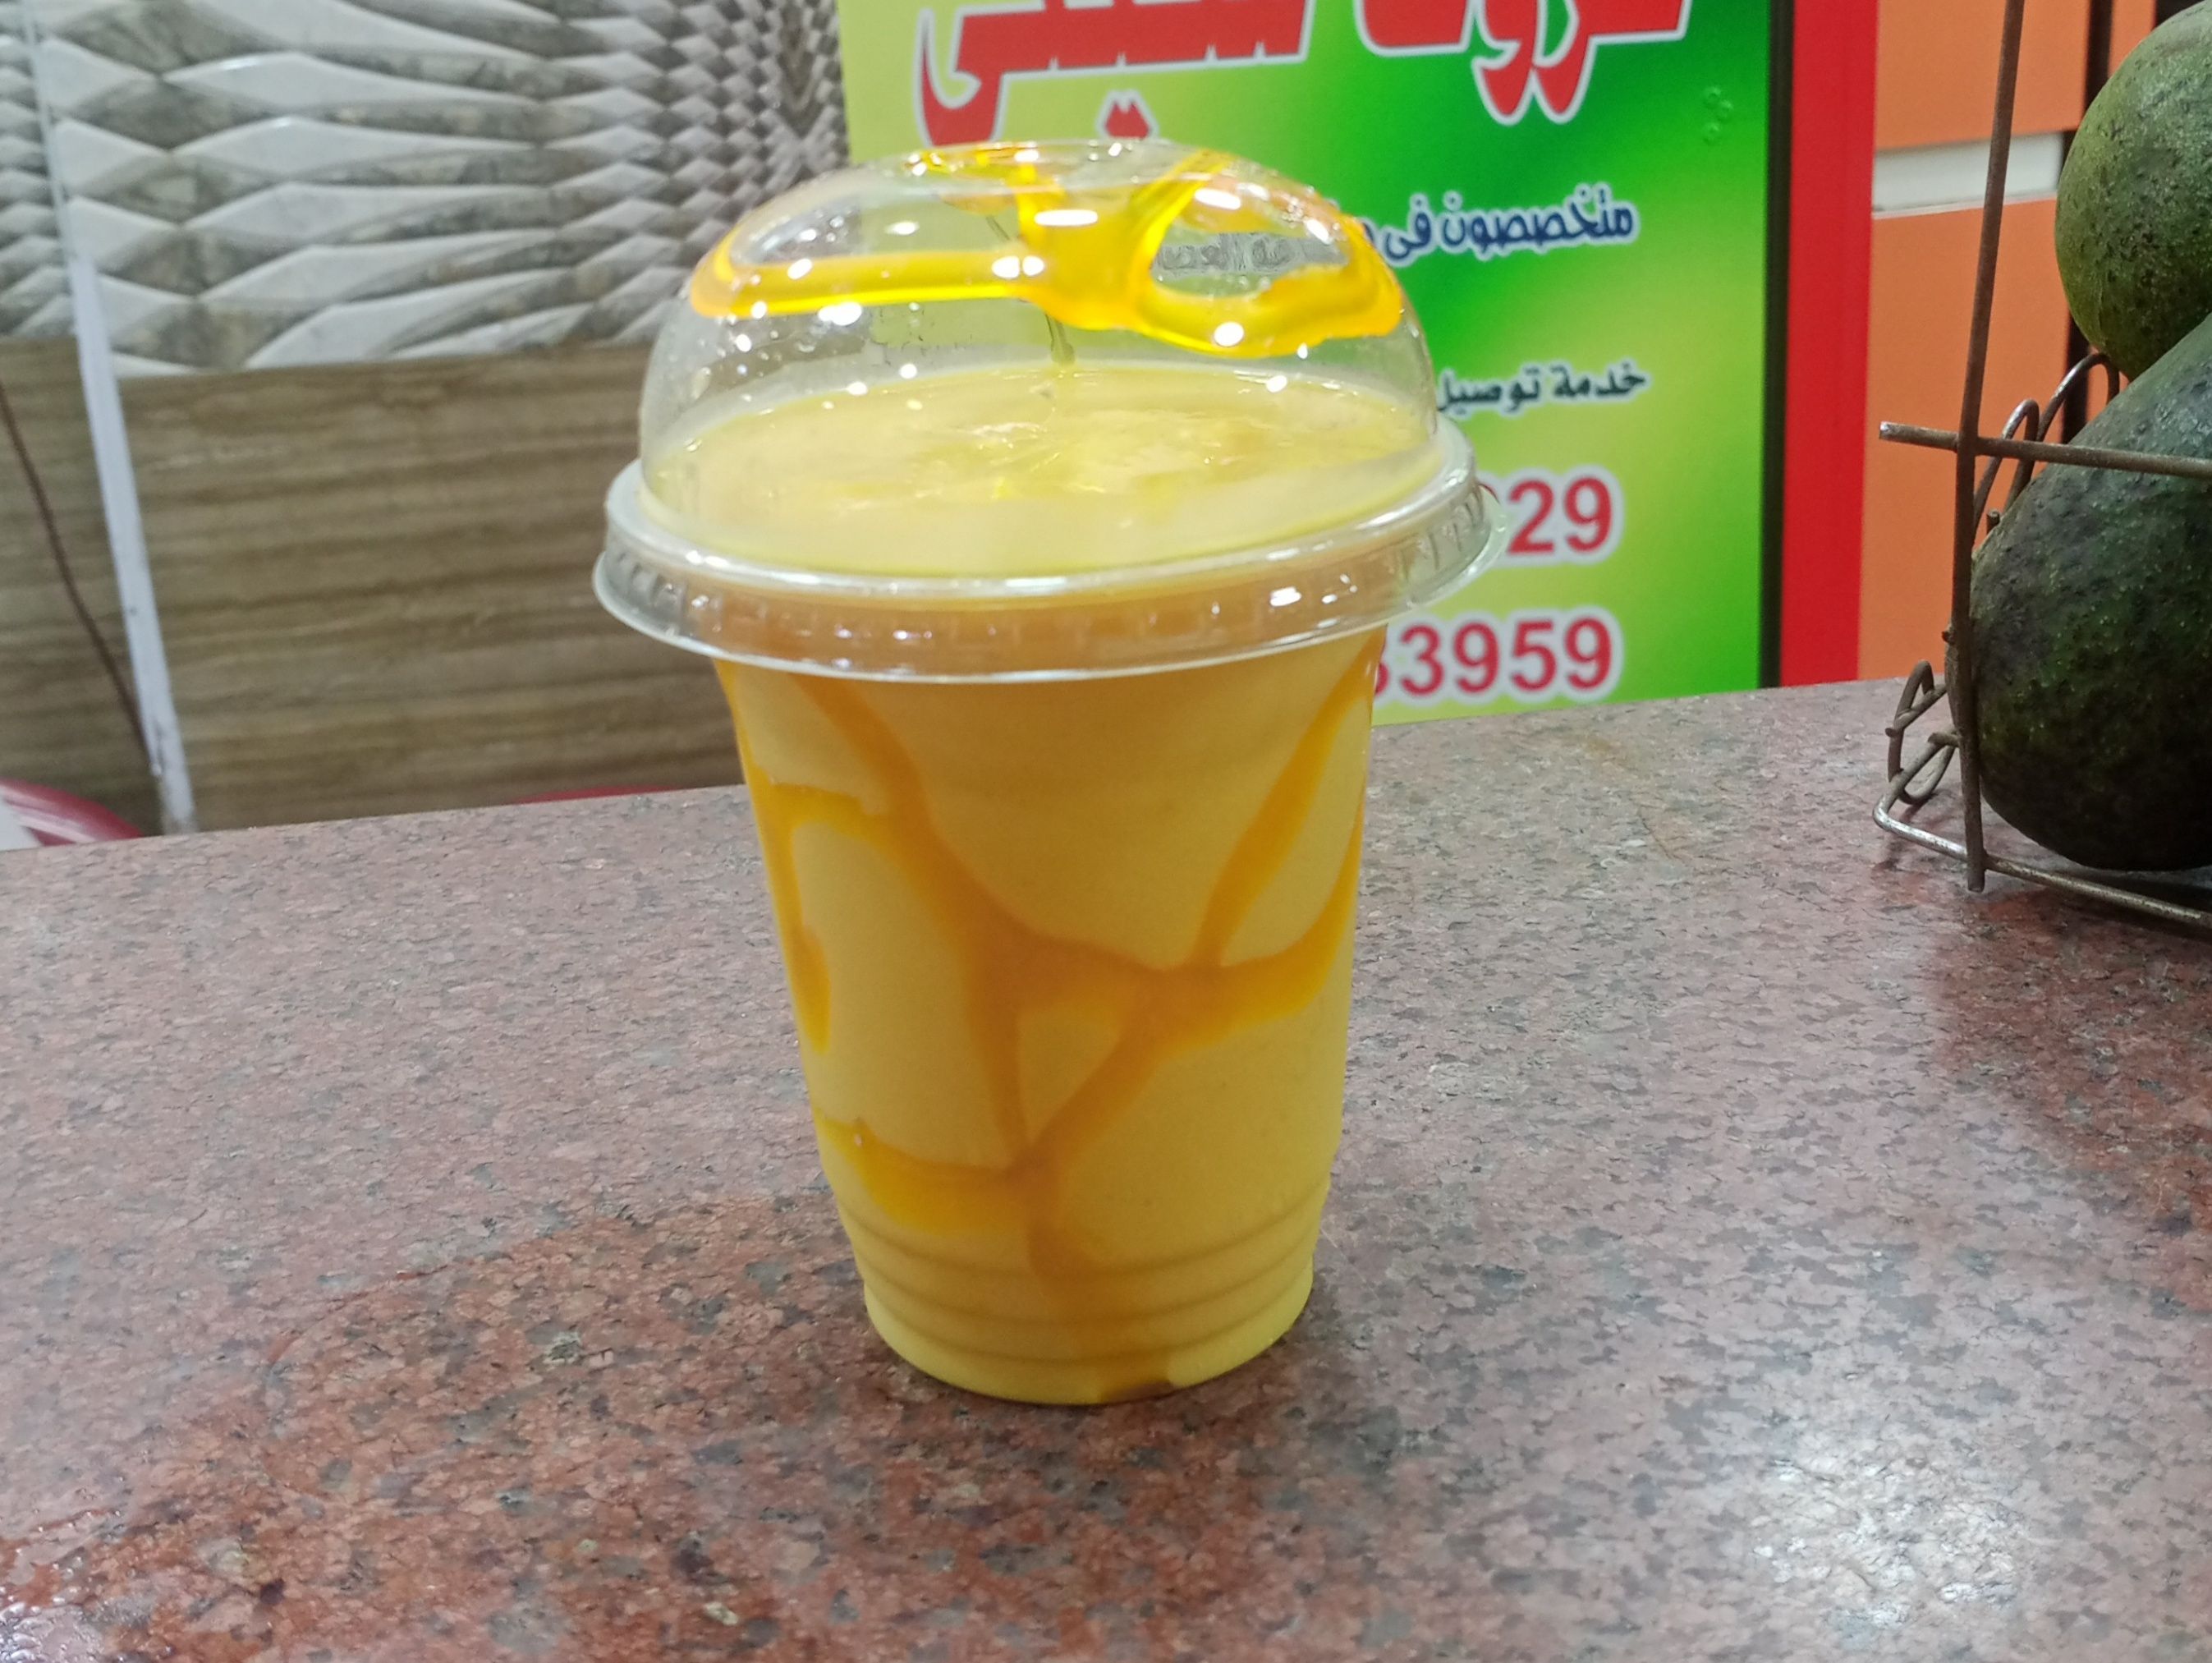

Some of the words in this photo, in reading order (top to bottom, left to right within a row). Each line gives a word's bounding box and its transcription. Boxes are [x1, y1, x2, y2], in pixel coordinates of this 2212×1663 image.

[1443, 188, 1632, 254] متخصصون
[1437, 367, 1540, 414] توصيل
[1554, 361, 1645, 397] خدمة
[1479, 477, 1612, 555] 29
[1375, 616, 1612, 696] 3959
